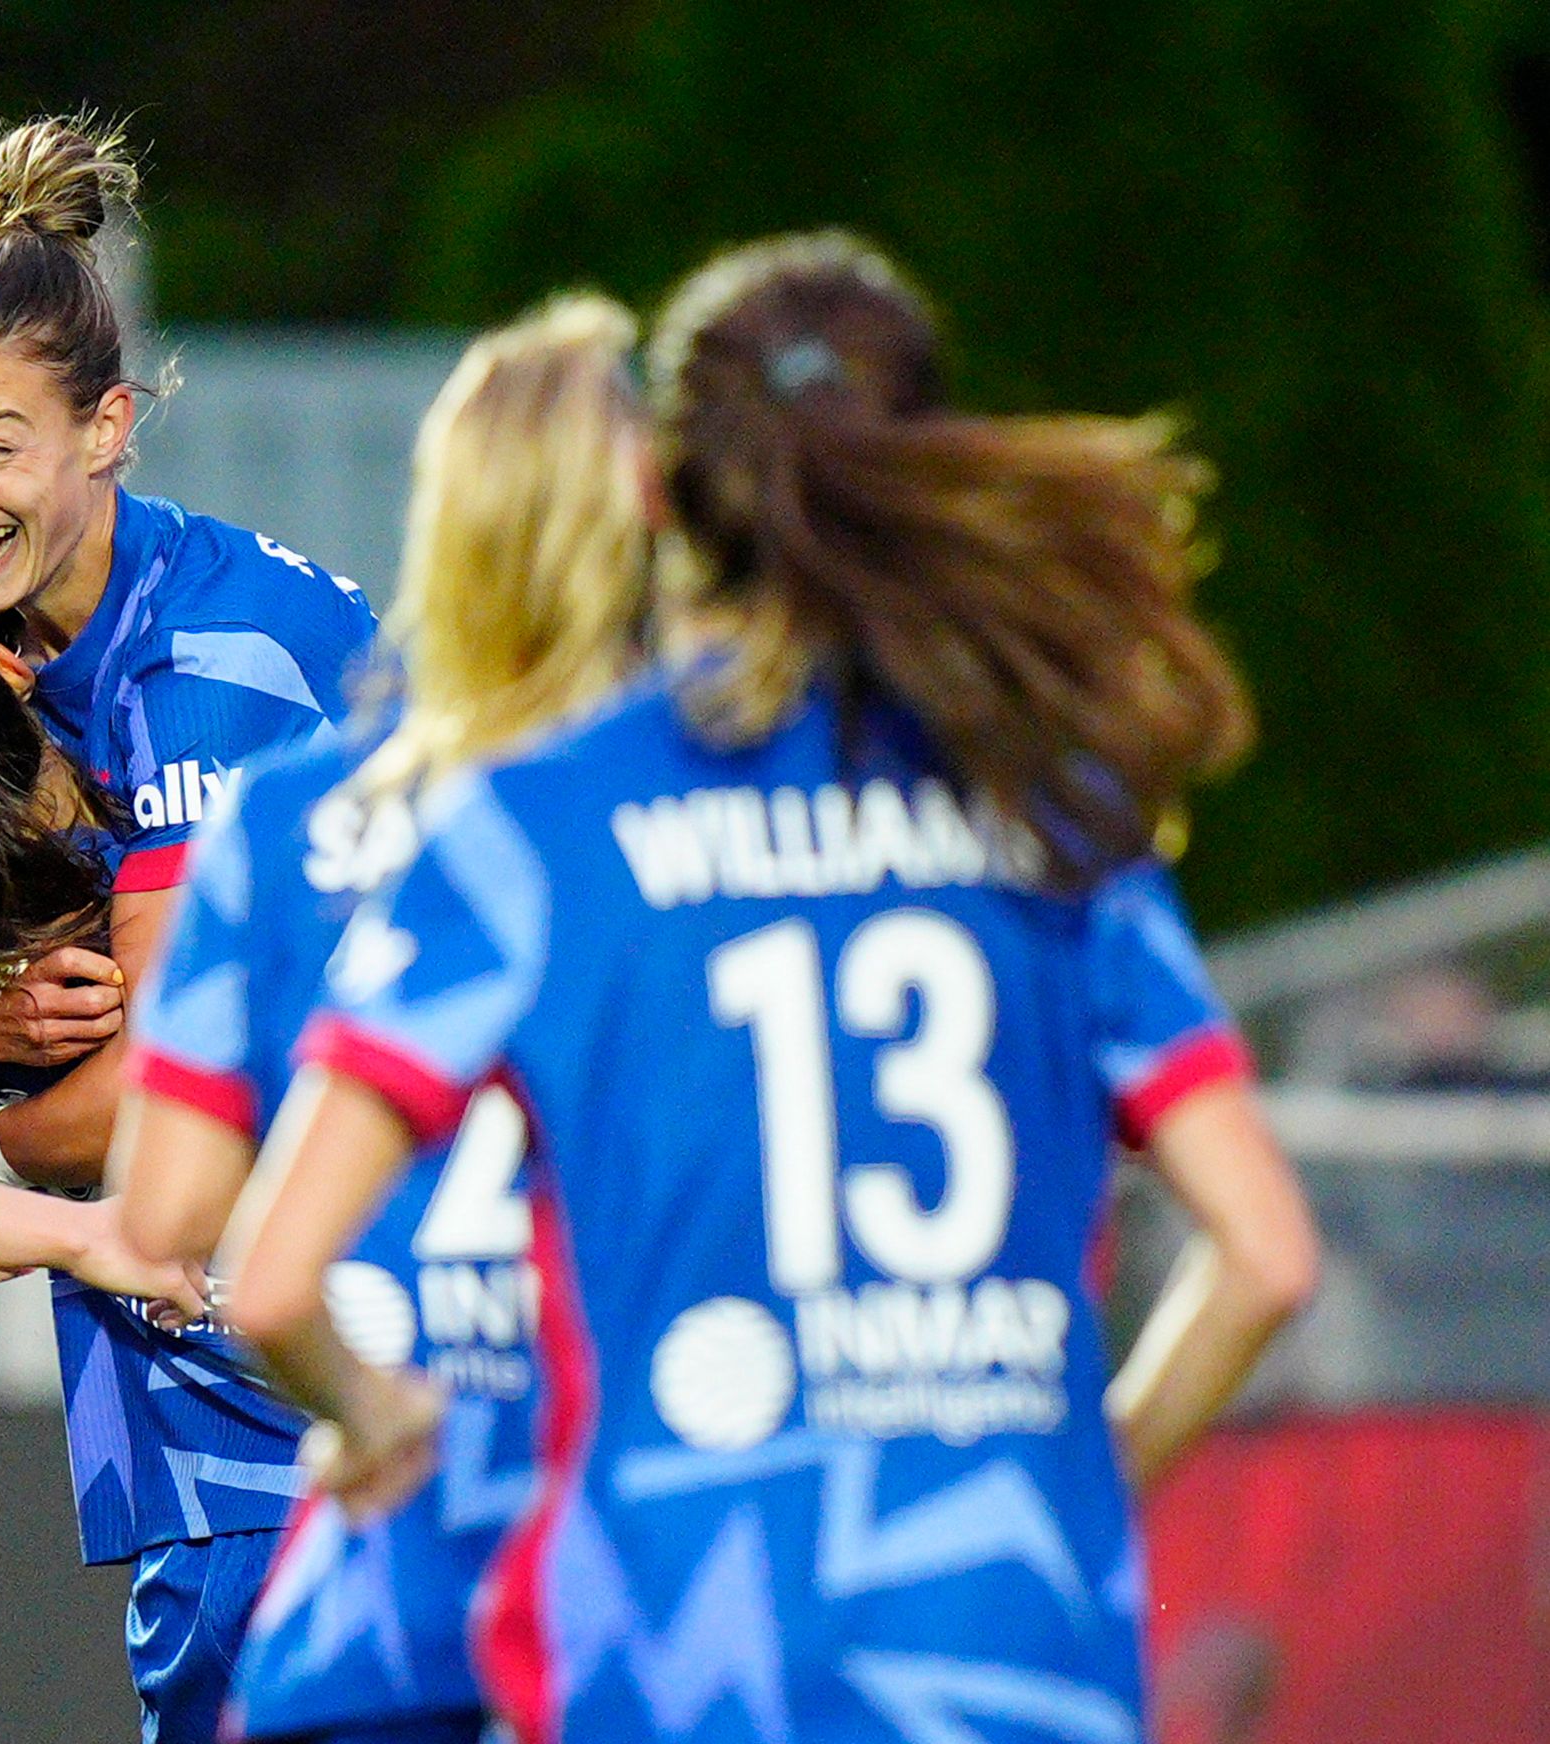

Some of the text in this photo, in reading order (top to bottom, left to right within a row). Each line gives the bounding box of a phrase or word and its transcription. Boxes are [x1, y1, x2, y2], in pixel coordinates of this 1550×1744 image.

[133, 758, 244, 830] ally
[610, 777, 1052, 910] WILLIAM
[705, 906, 1017, 1298] 13
[793, 1278, 1072, 1383] INMAR
